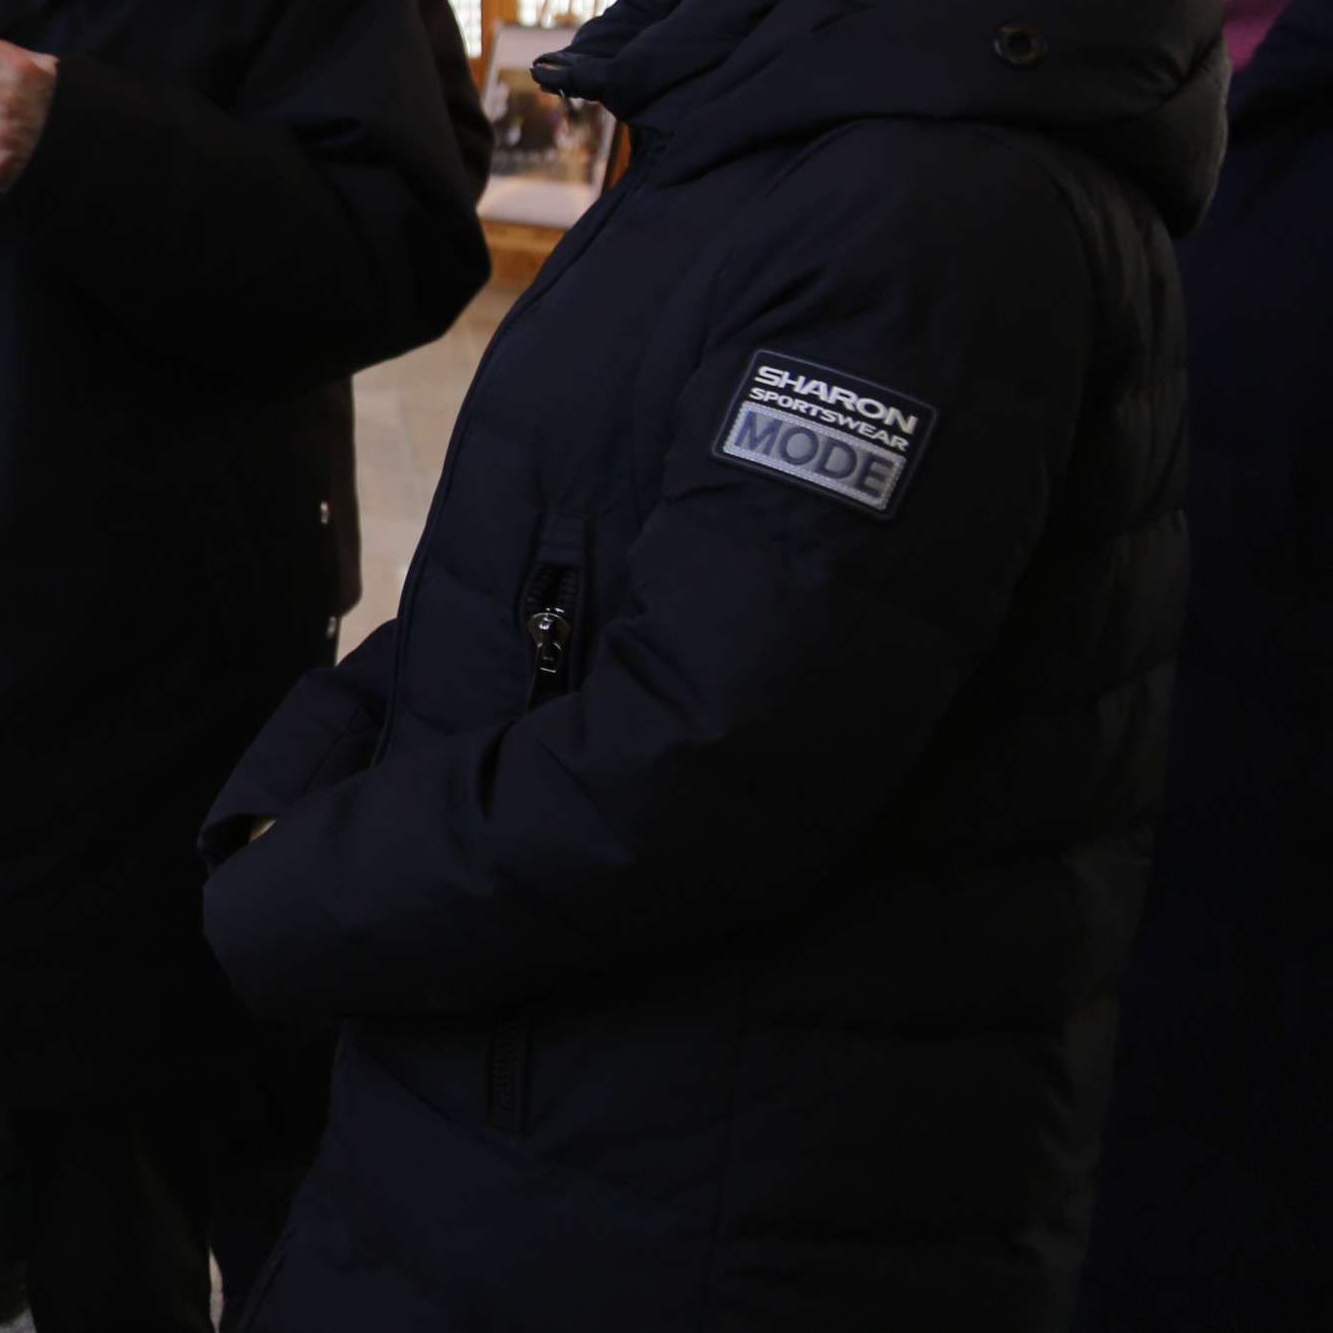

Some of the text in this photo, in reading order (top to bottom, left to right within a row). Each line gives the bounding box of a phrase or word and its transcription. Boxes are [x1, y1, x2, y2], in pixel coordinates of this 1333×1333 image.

[749, 386, 909, 452] SPORTSWEAR
[754, 365, 918, 435] SHARON
[734, 410, 896, 499] MODE
